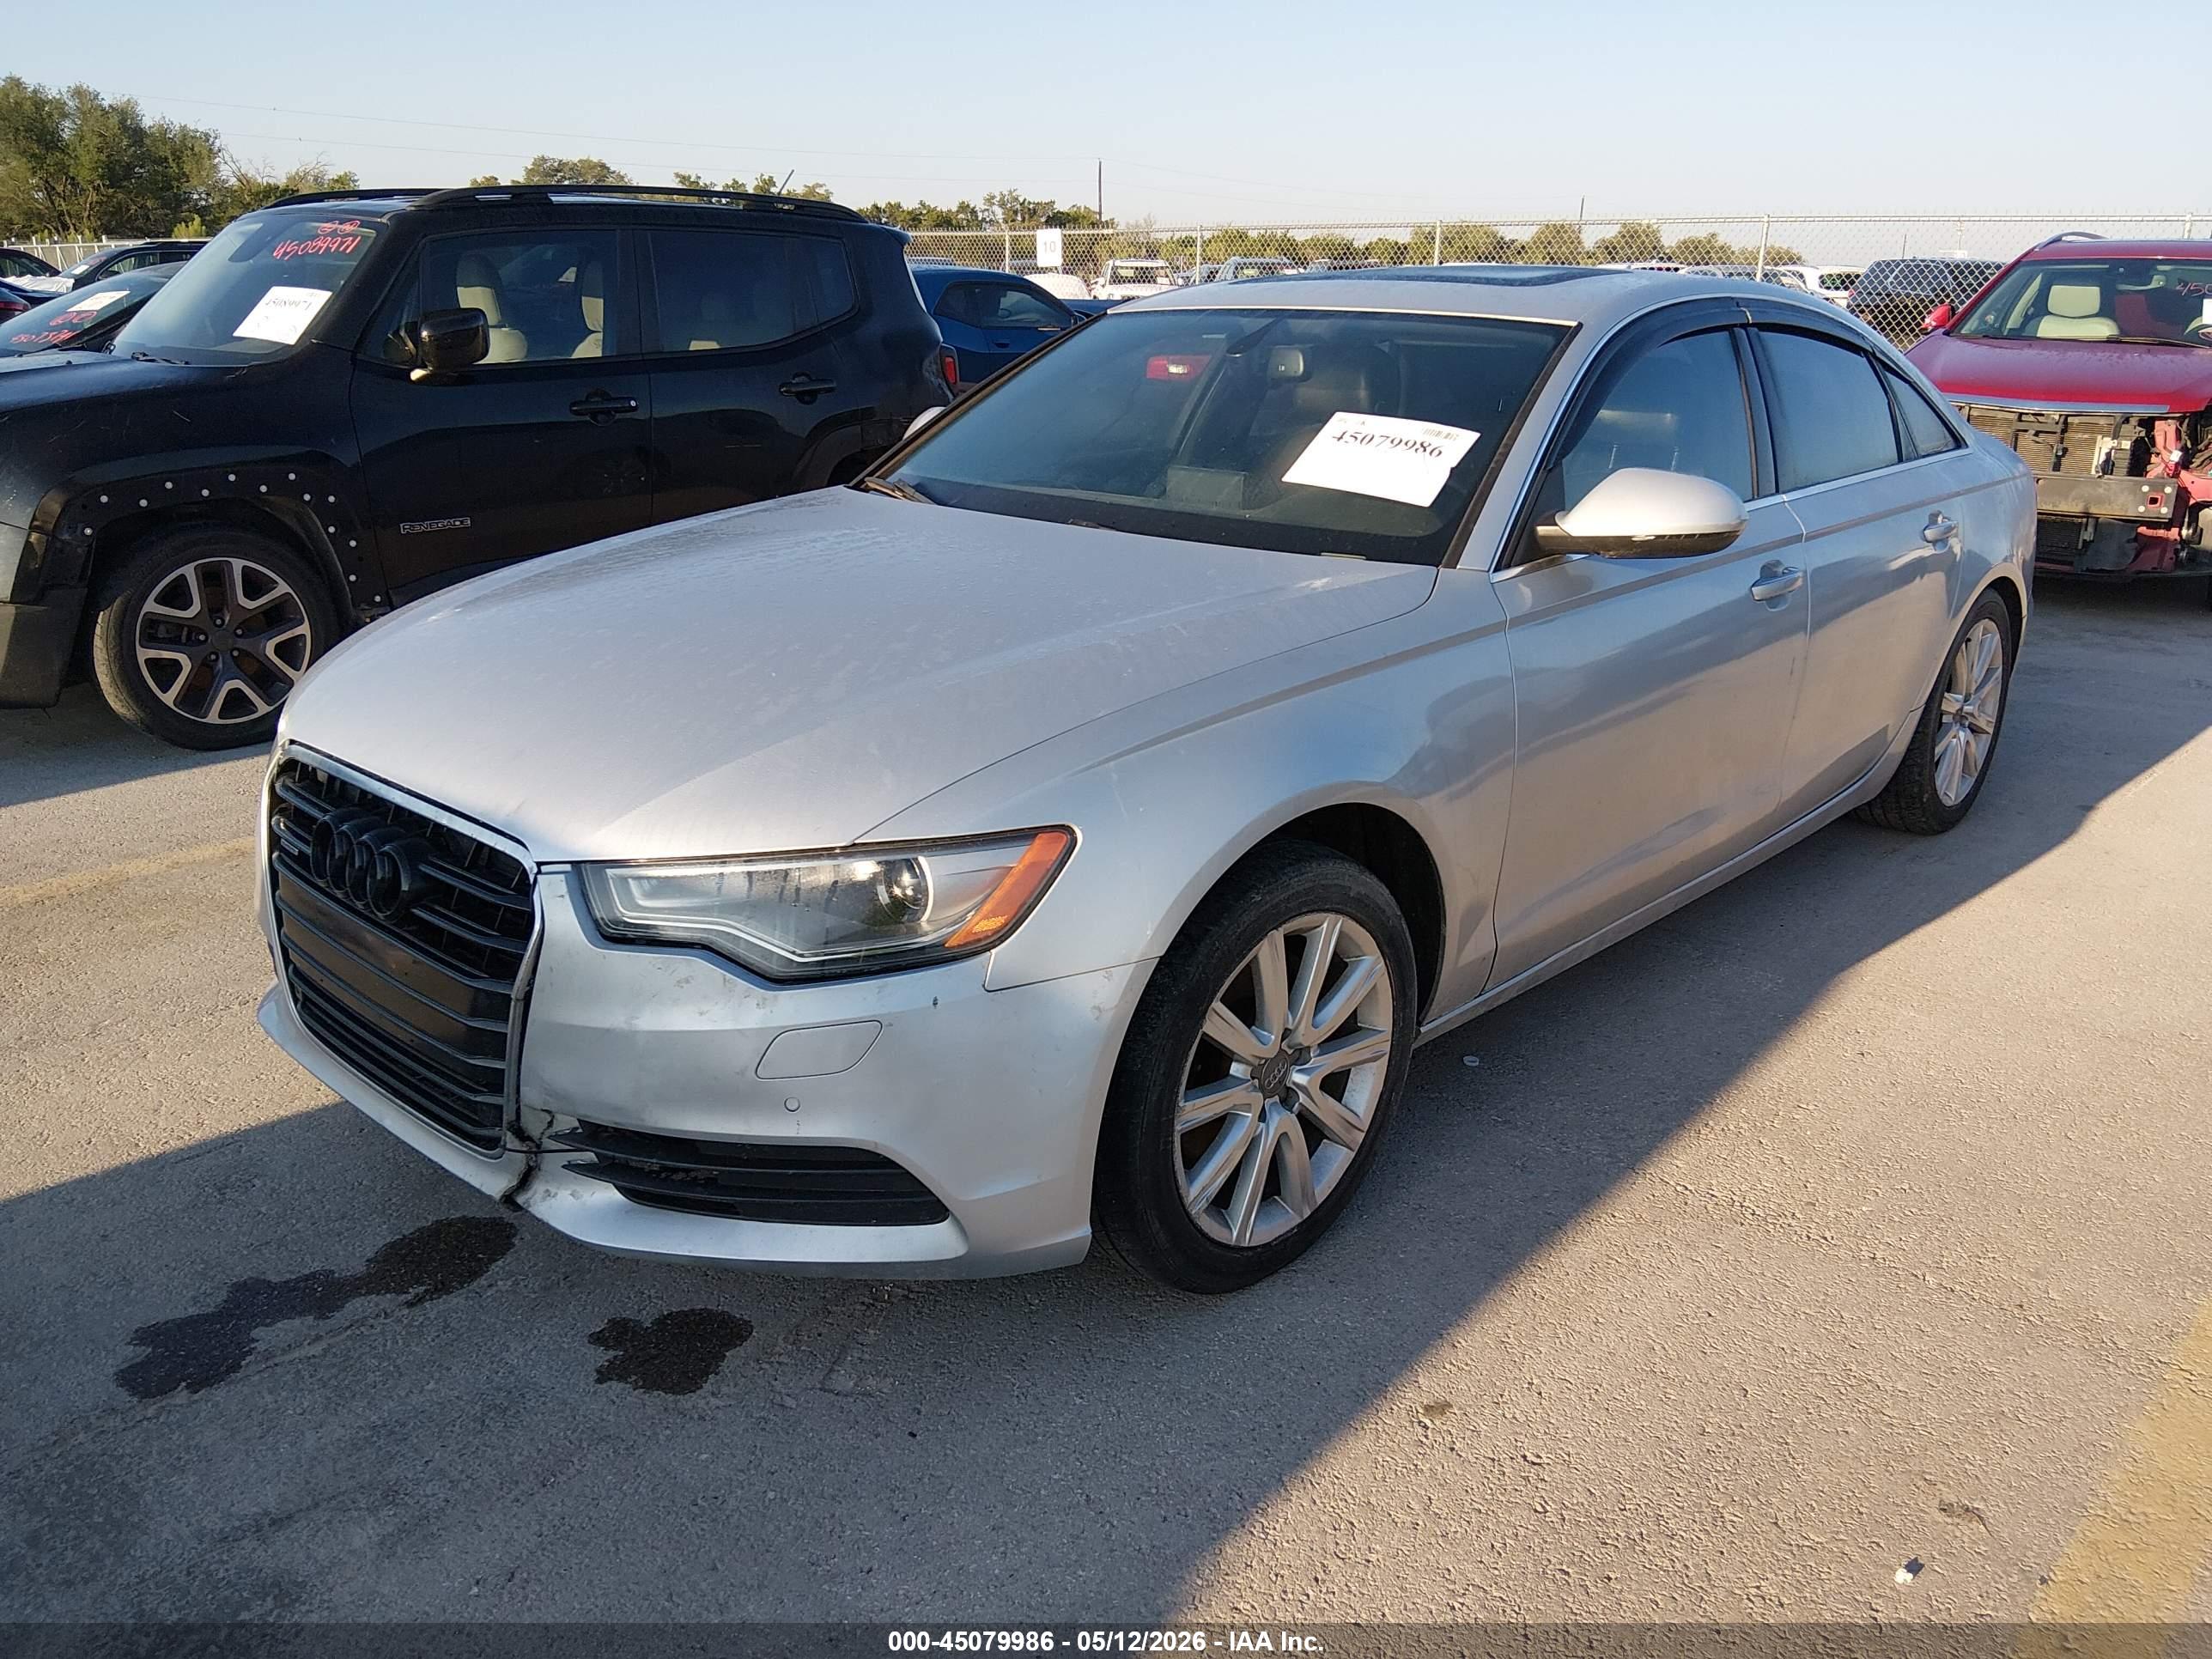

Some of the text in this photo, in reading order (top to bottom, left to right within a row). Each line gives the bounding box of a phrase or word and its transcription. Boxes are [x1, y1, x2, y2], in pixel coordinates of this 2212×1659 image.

[272, 235, 362, 260] 45089971
[1043, 240, 1057, 254] 10
[1332, 429, 1445, 459] 45079986
[399, 517, 471, 534] RENEGADE
